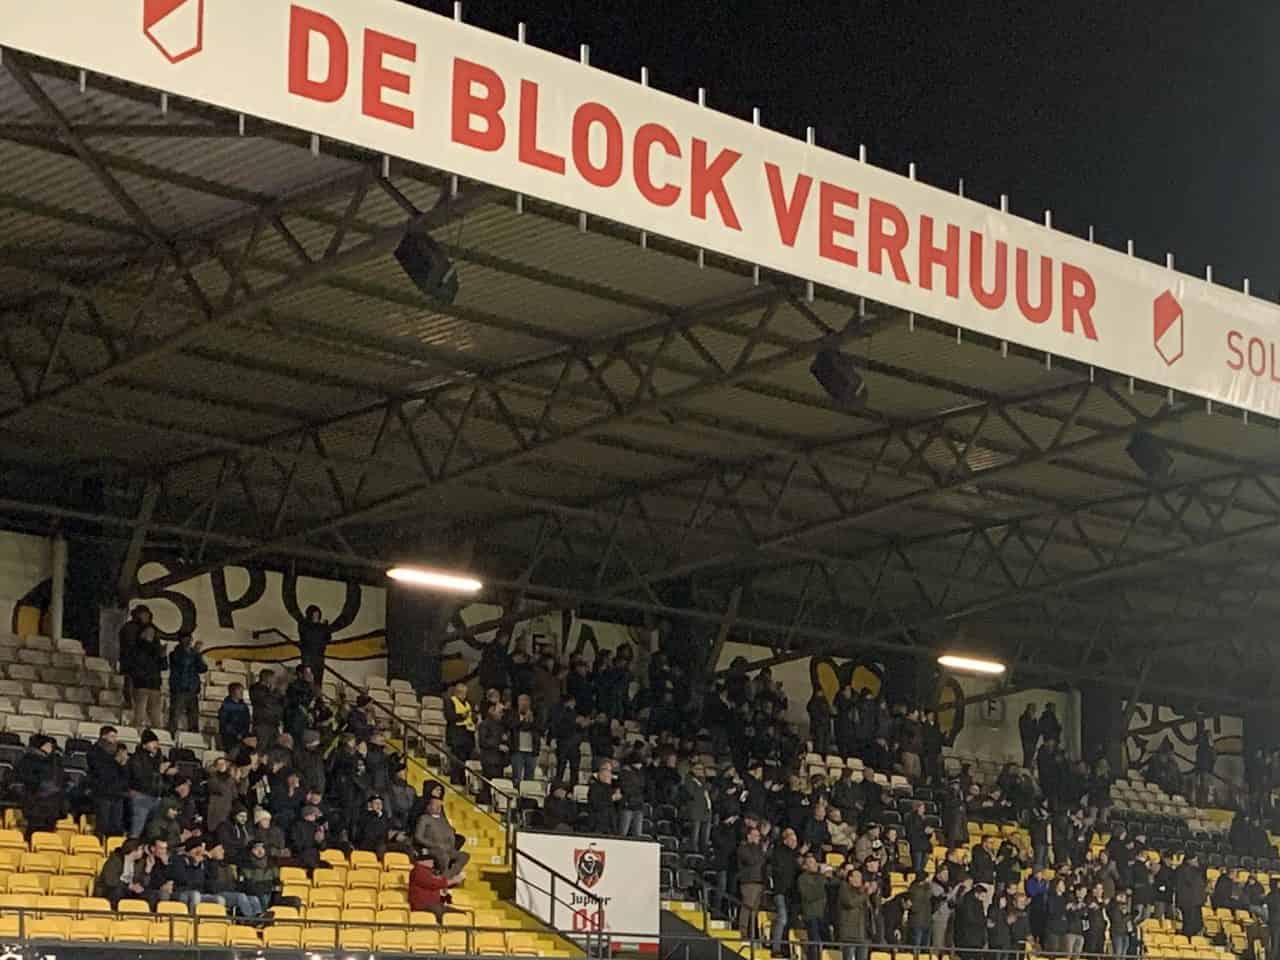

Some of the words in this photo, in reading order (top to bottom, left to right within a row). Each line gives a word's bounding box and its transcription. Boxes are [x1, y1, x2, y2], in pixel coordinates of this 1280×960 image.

[288, 4, 417, 130] DE
[451, 57, 742, 232] BLOCK
[764, 161, 1099, 341] VERHUUR
